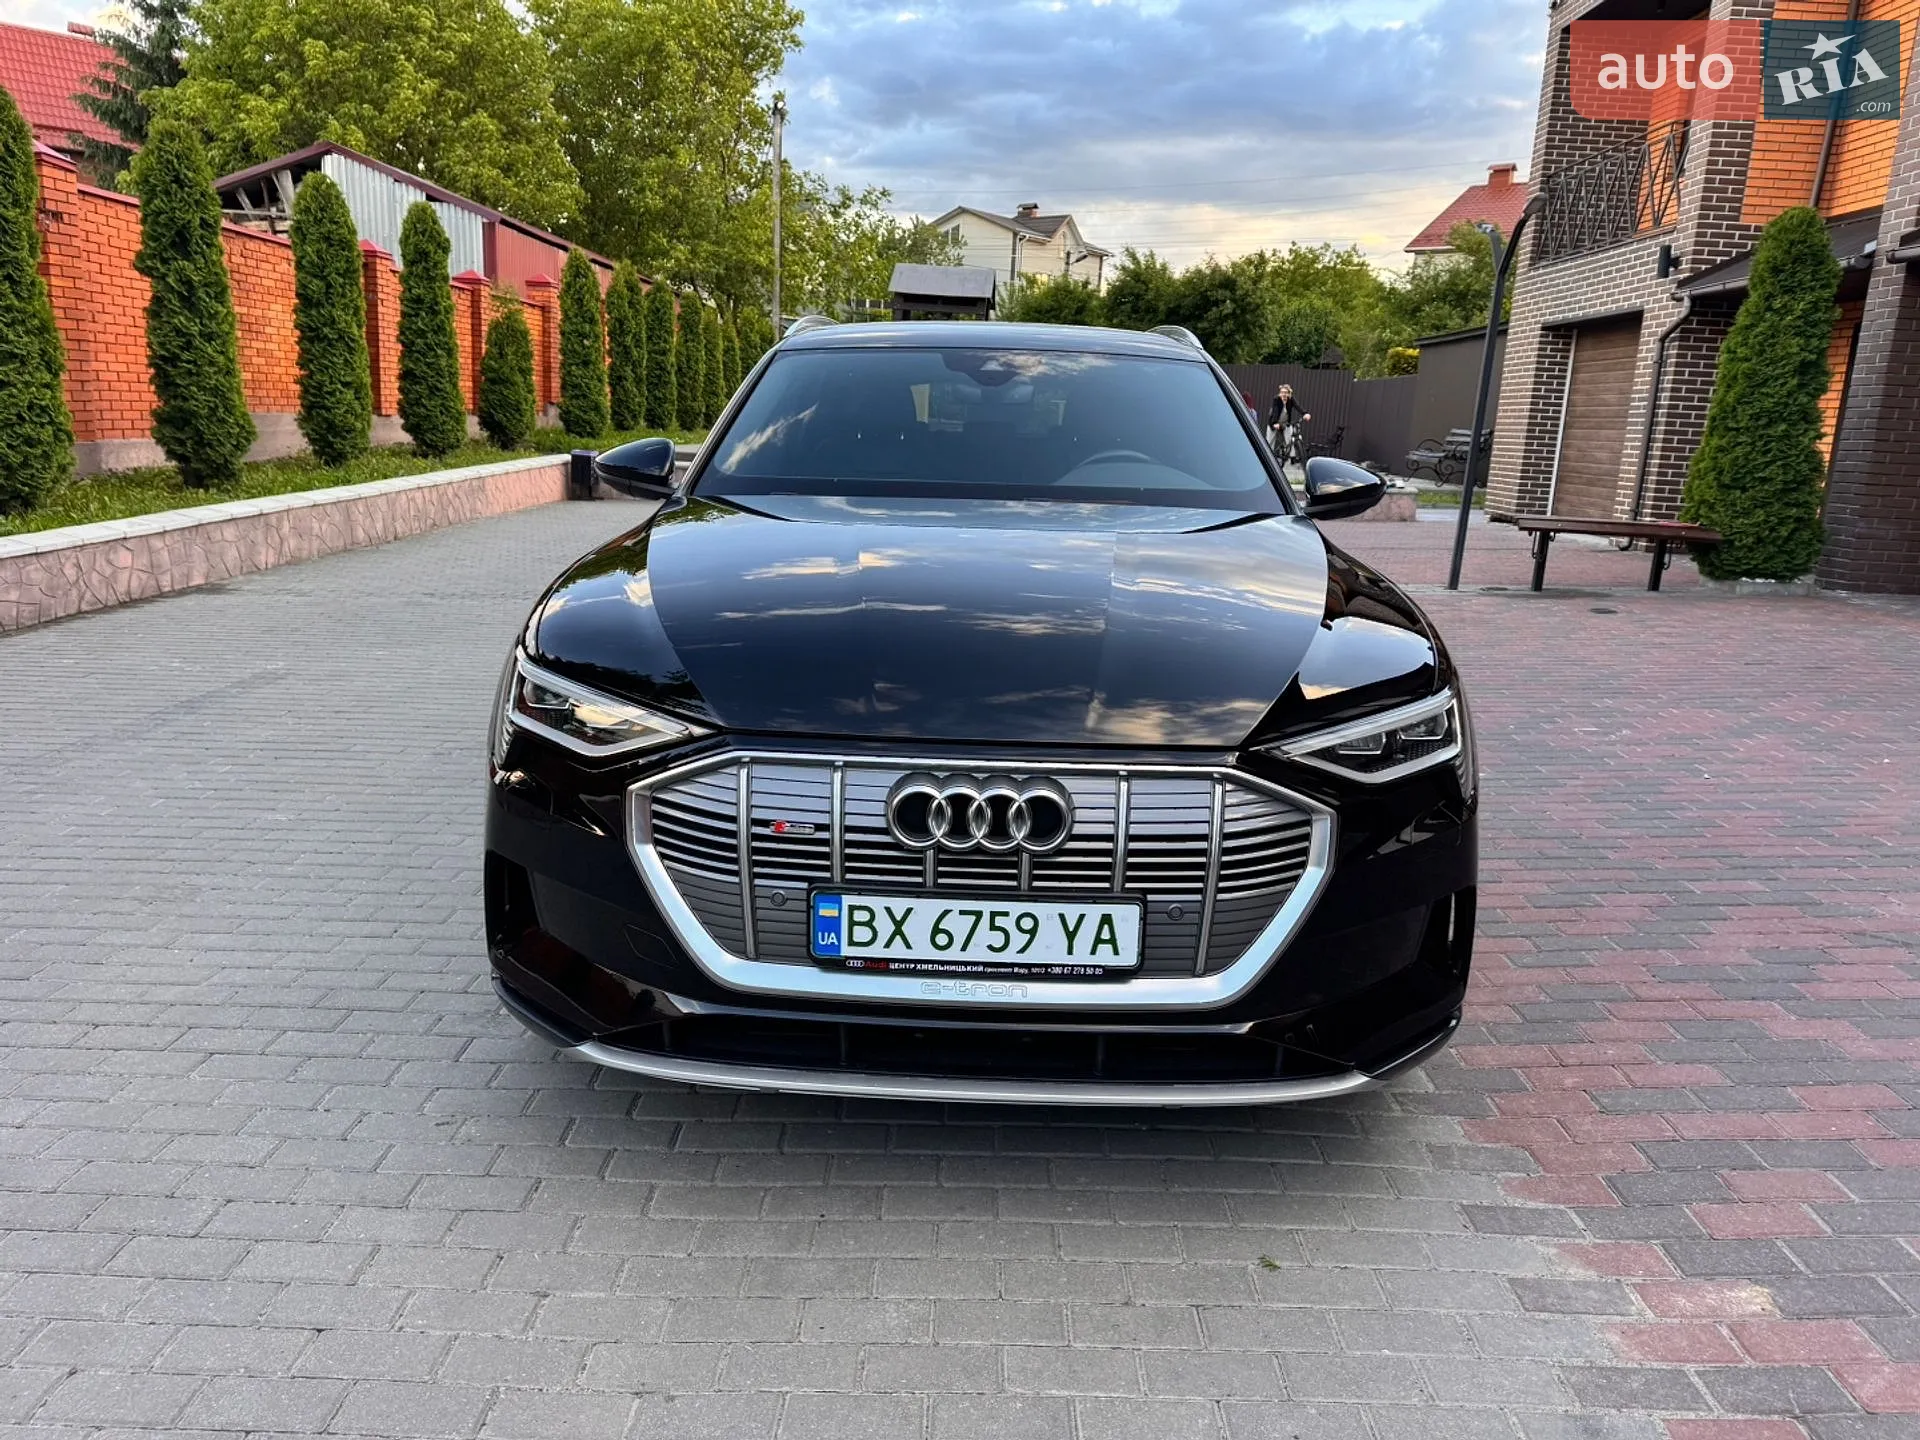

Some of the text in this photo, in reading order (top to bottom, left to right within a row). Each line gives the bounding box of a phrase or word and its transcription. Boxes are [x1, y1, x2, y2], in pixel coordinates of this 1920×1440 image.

[818, 931, 839, 945] UA
[847, 904, 1120, 956] BX 6759 YA
[920, 980, 1028, 999] e-tron
